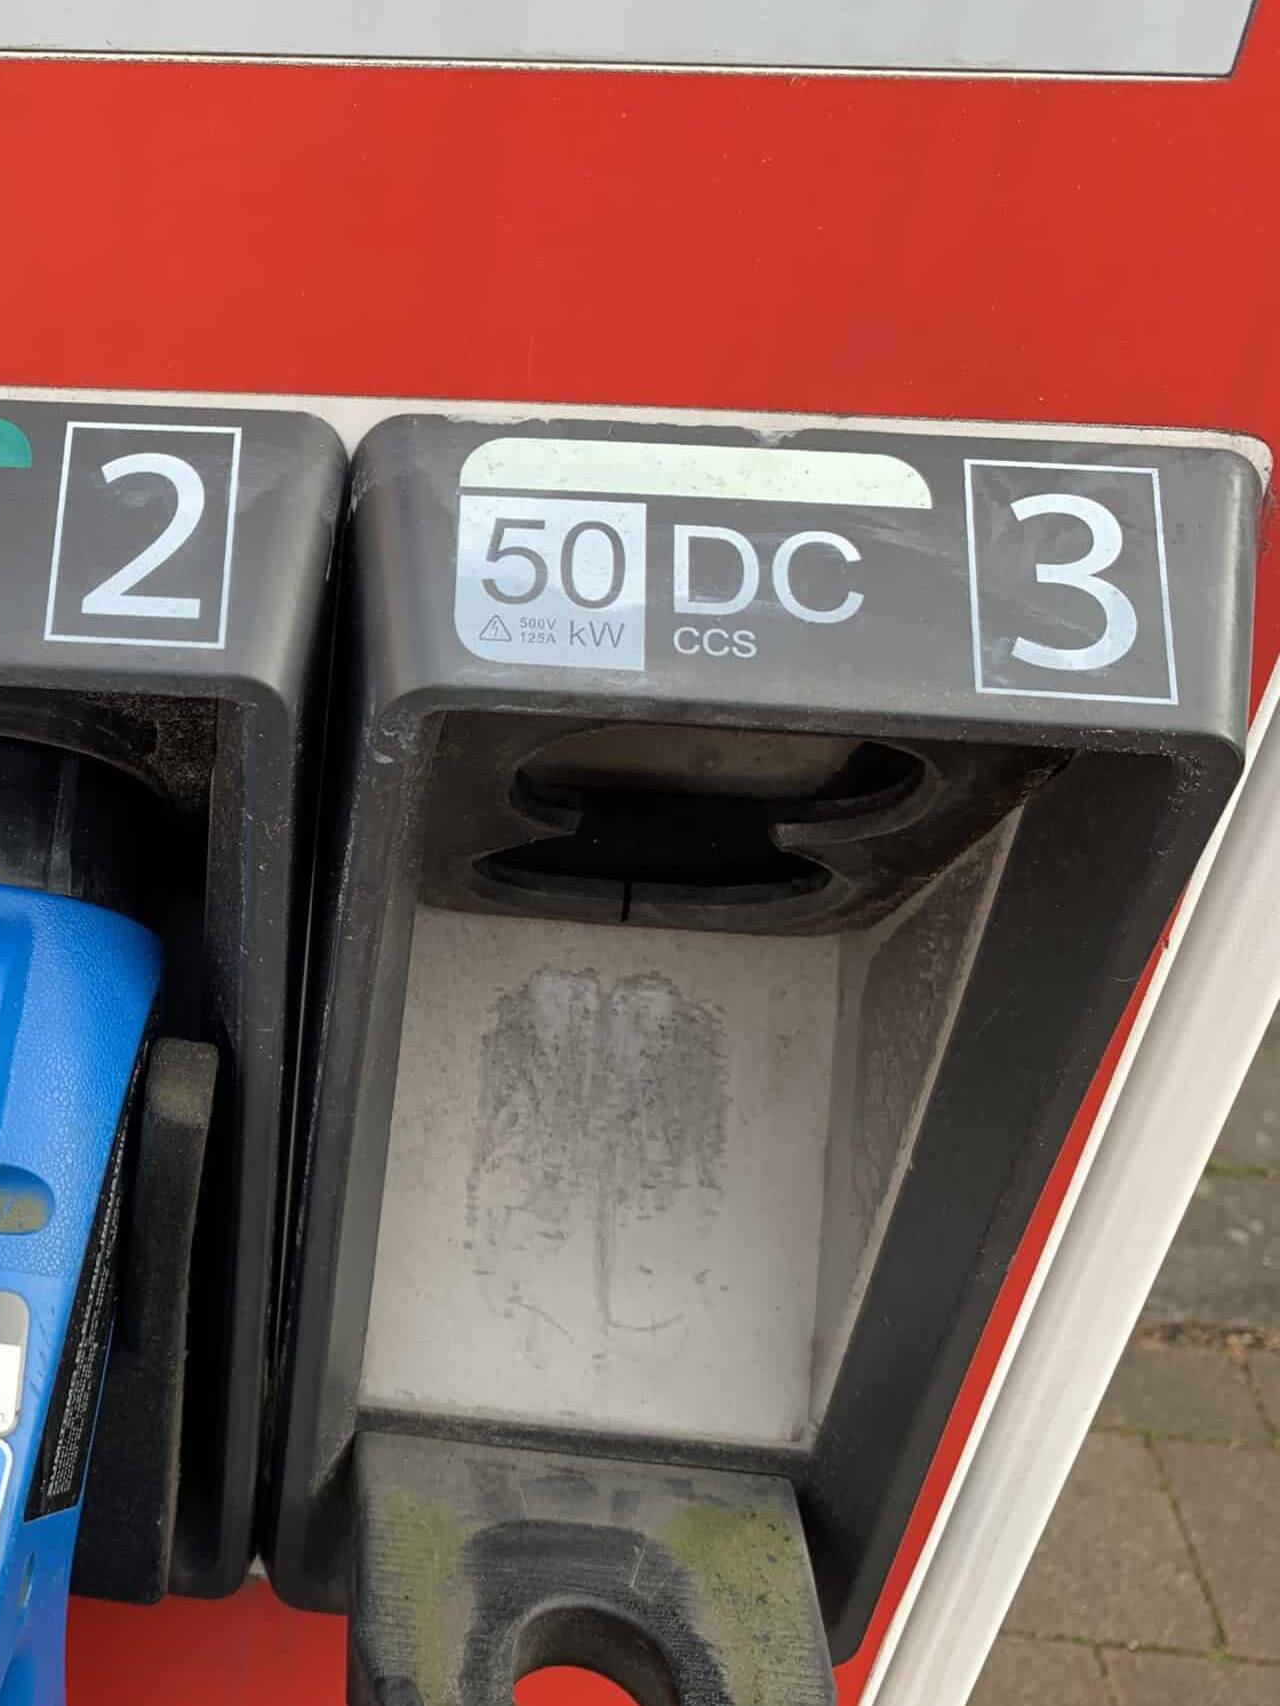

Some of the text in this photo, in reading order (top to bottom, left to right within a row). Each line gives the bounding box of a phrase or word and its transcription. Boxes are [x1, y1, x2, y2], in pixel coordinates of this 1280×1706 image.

[81, 452, 206, 619] 2
[480, 518, 865, 623] 50 DC
[1009, 493, 1138, 671] 3
[520, 617, 557, 629] 500V
[520, 632, 556, 644] 125A
[571, 620, 624, 648] kW
[673, 626, 757, 658] CCS
